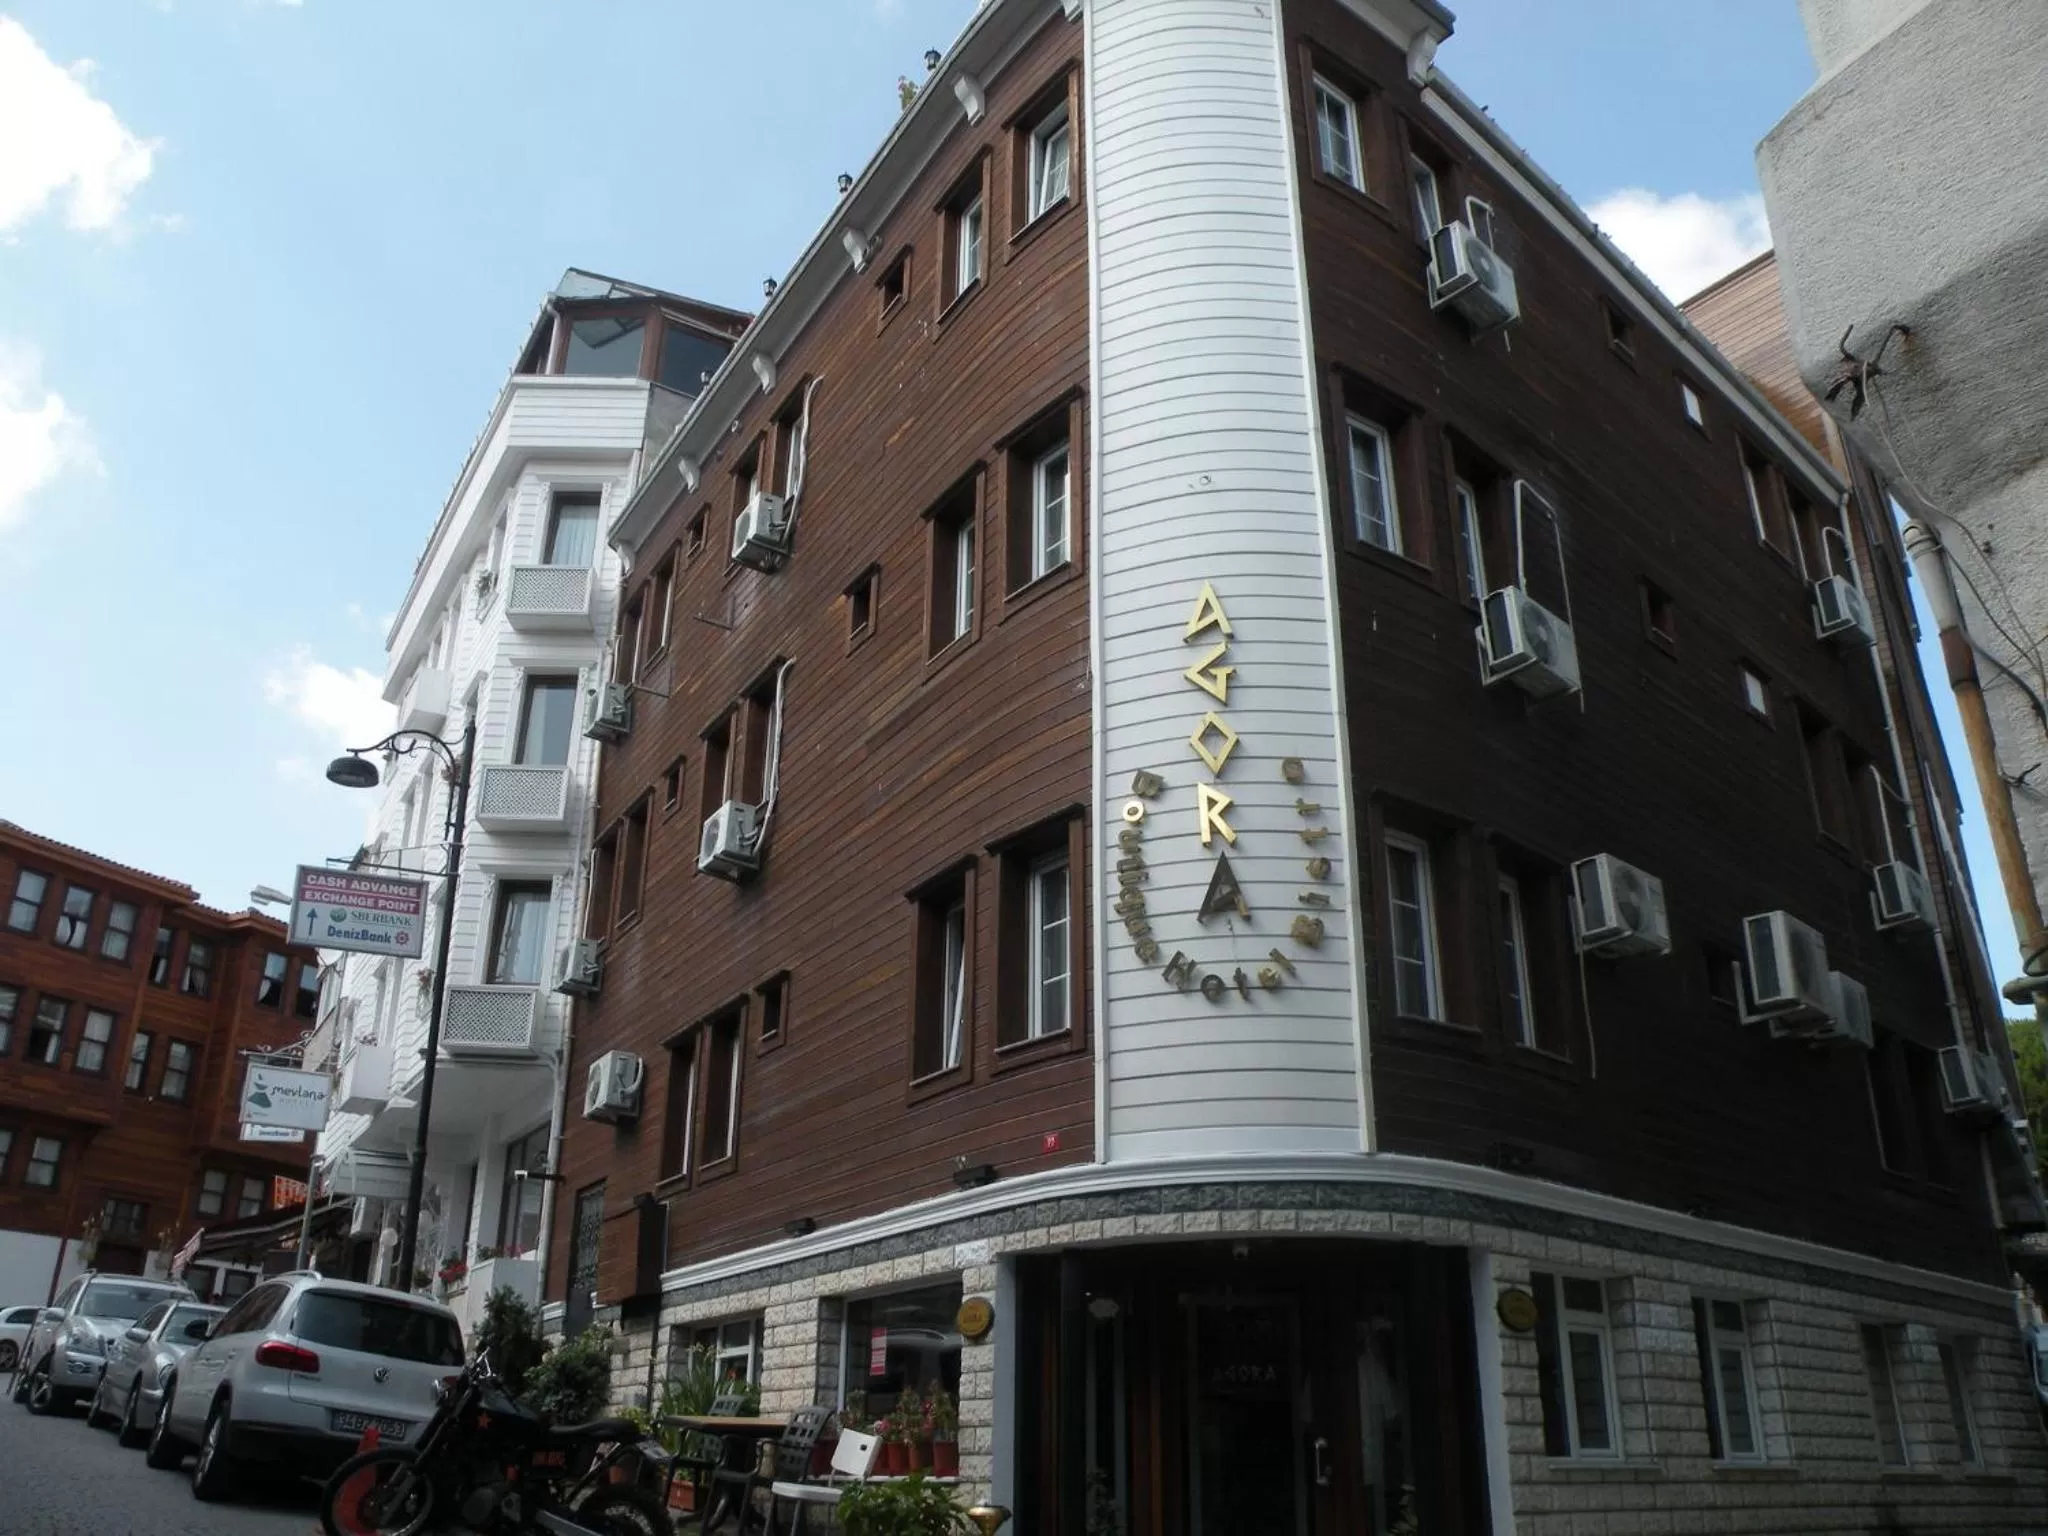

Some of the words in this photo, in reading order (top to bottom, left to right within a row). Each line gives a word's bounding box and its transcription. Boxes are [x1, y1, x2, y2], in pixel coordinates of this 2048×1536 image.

[1183, 579, 1253, 923] AGORA
[306, 874, 346, 889] CASH
[351, 879, 417, 897] ADVANCE
[304, 890, 375, 908] EXCHANGE
[377, 899, 417, 911] POINT
[351, 910, 413, 926] SBERBANK
[327, 925, 391, 944] DenizBank
[1161, 946, 1298, 1003] Hotel
